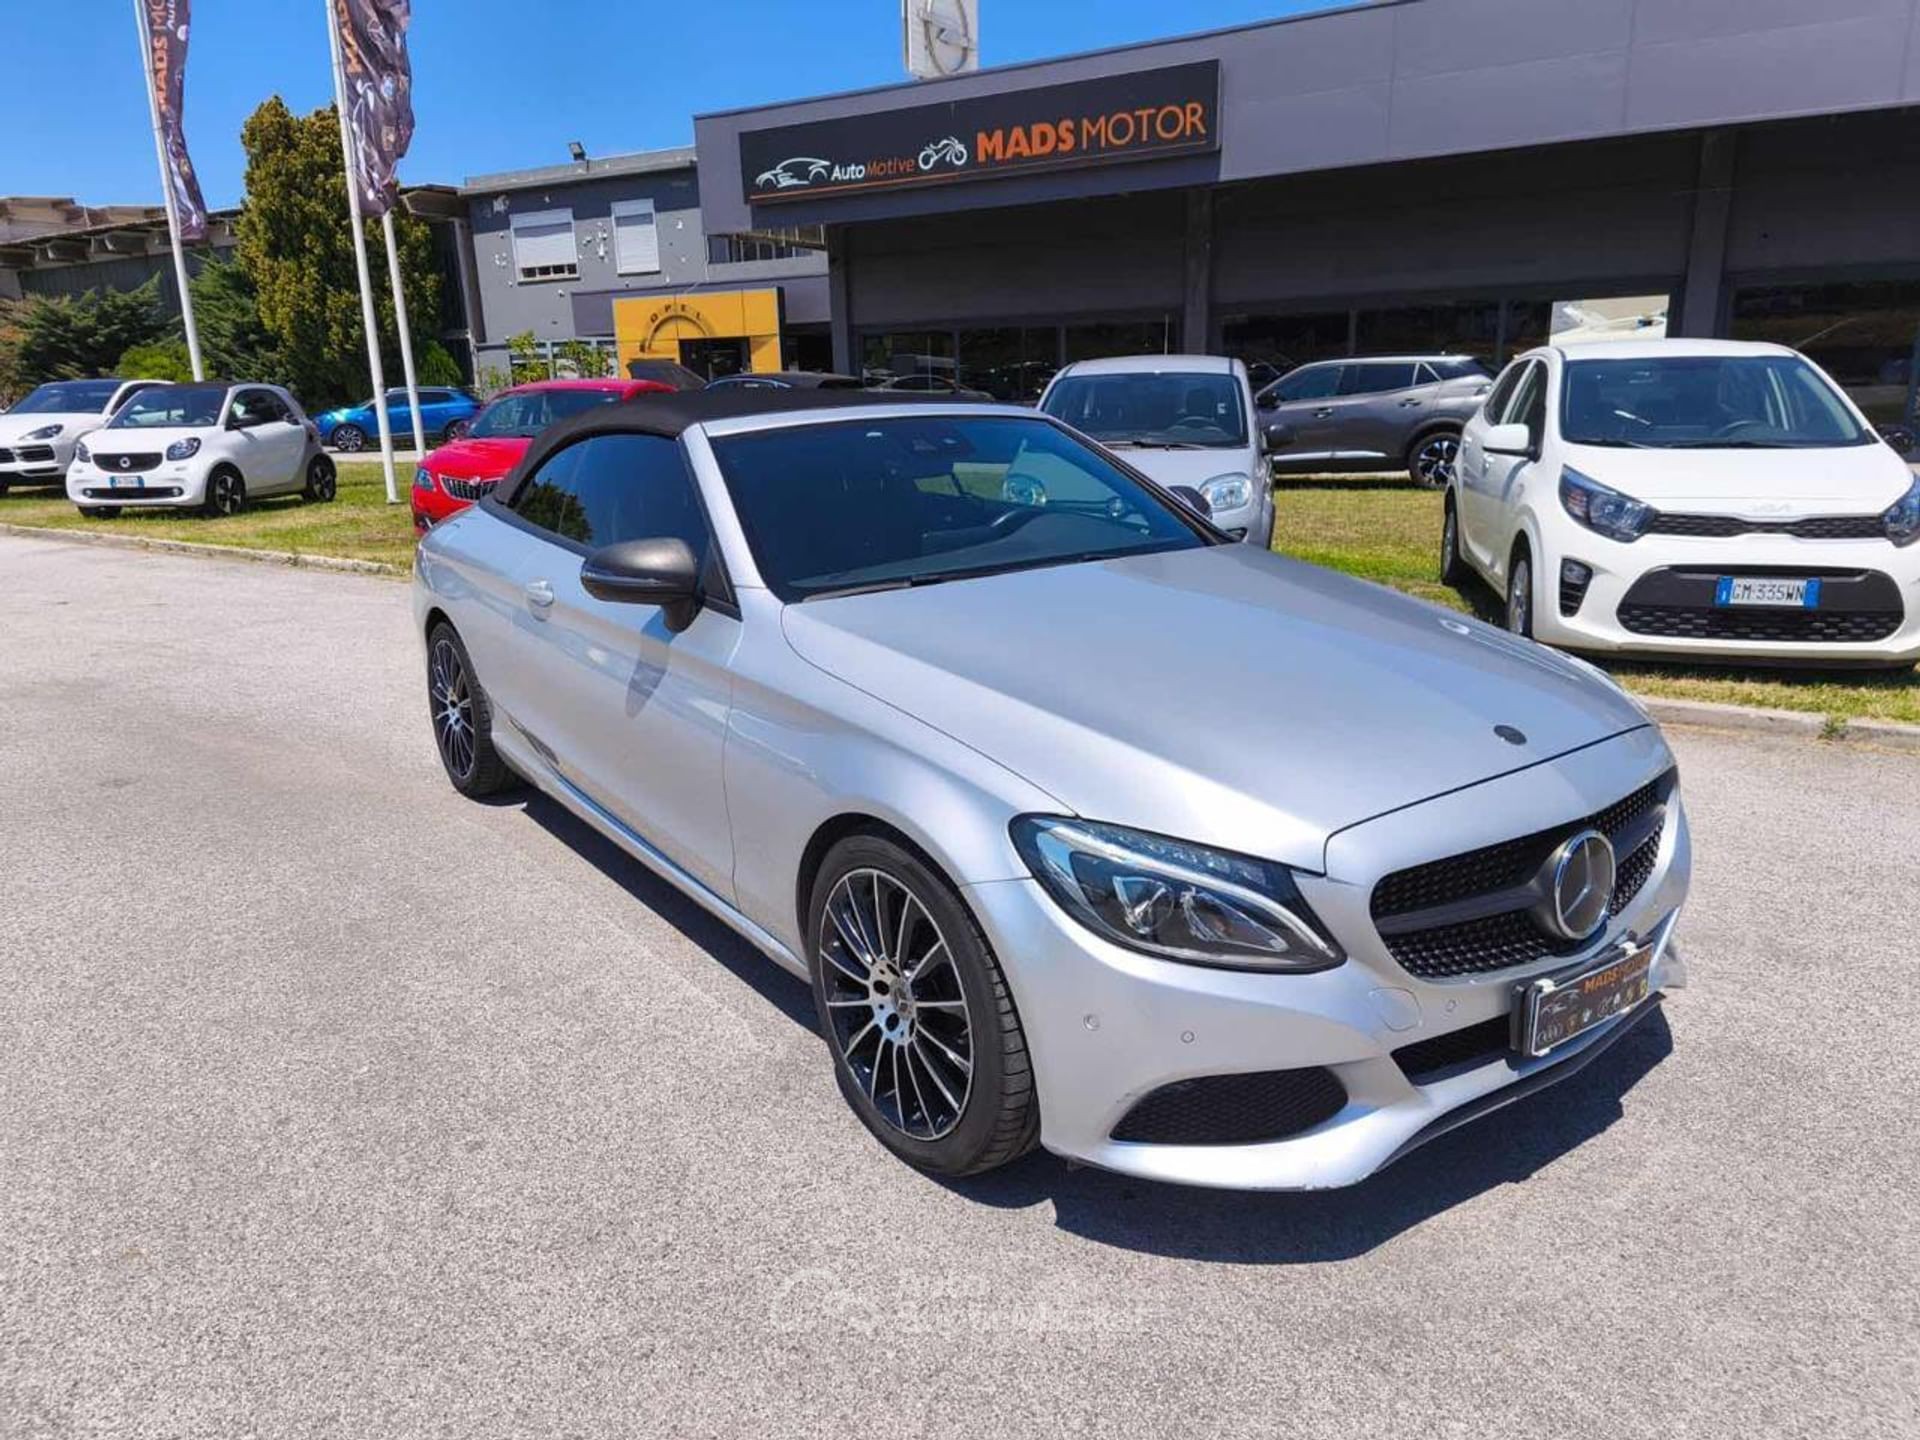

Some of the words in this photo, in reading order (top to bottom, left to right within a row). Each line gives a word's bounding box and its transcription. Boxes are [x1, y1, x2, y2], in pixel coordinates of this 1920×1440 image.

[976, 118, 1076, 163] MADS
[1081, 102, 1207, 150] MOTOR
[650, 303, 702, 324] OPEL
